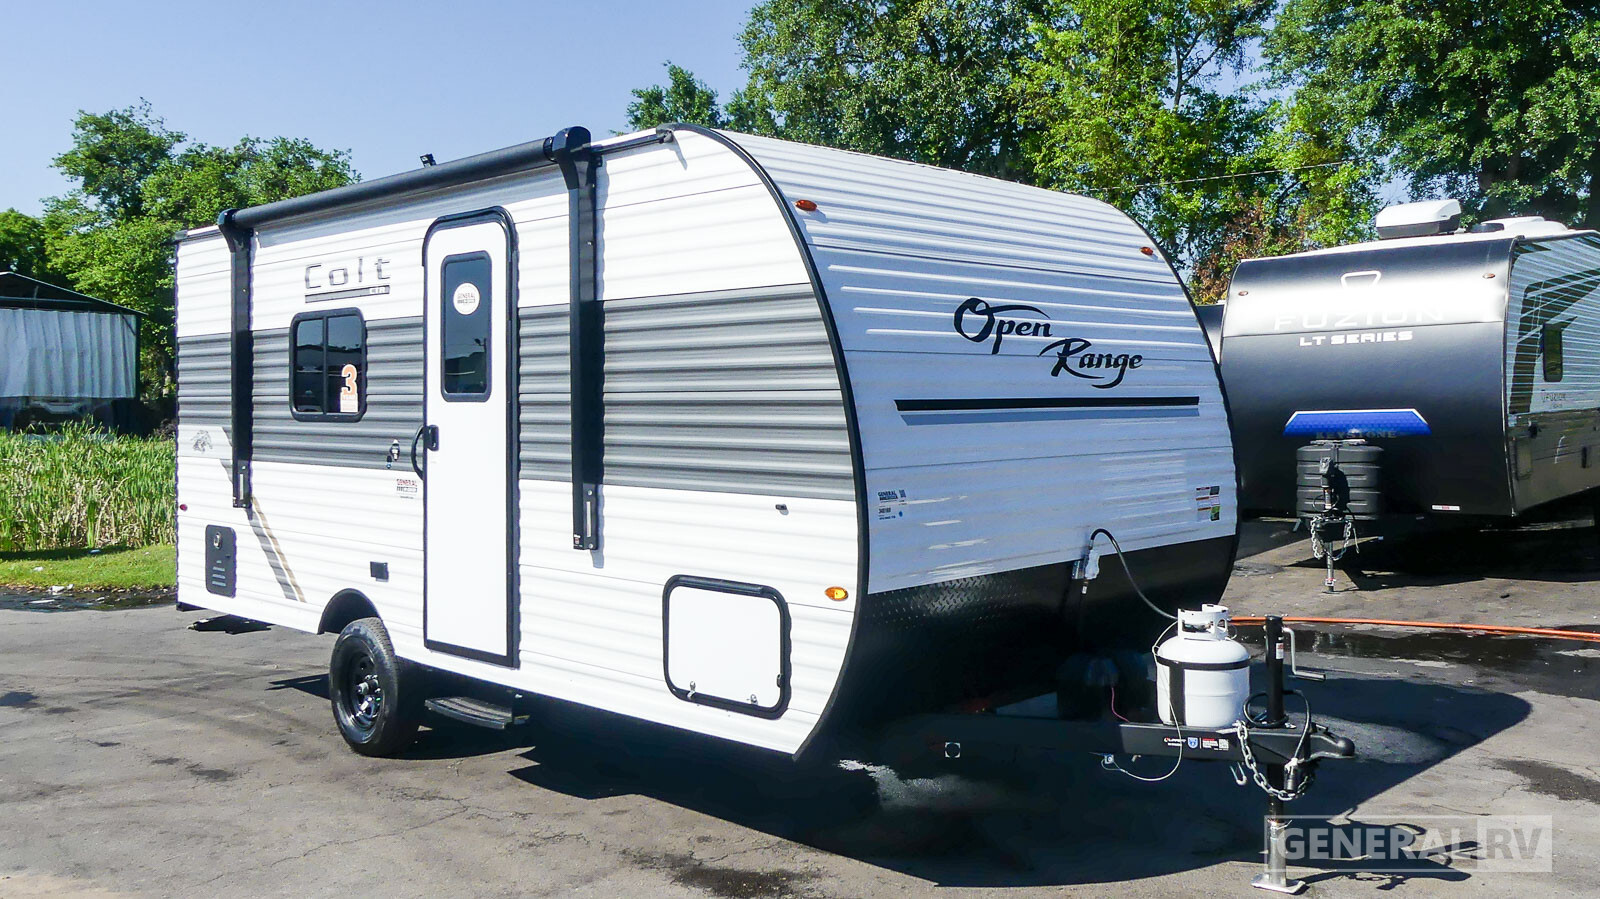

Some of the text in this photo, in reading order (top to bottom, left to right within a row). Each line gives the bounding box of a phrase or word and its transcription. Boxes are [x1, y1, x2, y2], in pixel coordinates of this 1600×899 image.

[305, 256, 391, 289] Colt
[953, 297, 1053, 355] Open
[1299, 330, 1413, 347] LT SERIES
[341, 363, 358, 395] 3
[1037, 337, 1144, 389] Range
[1315, 430, 1398, 439] KEYSTONE
